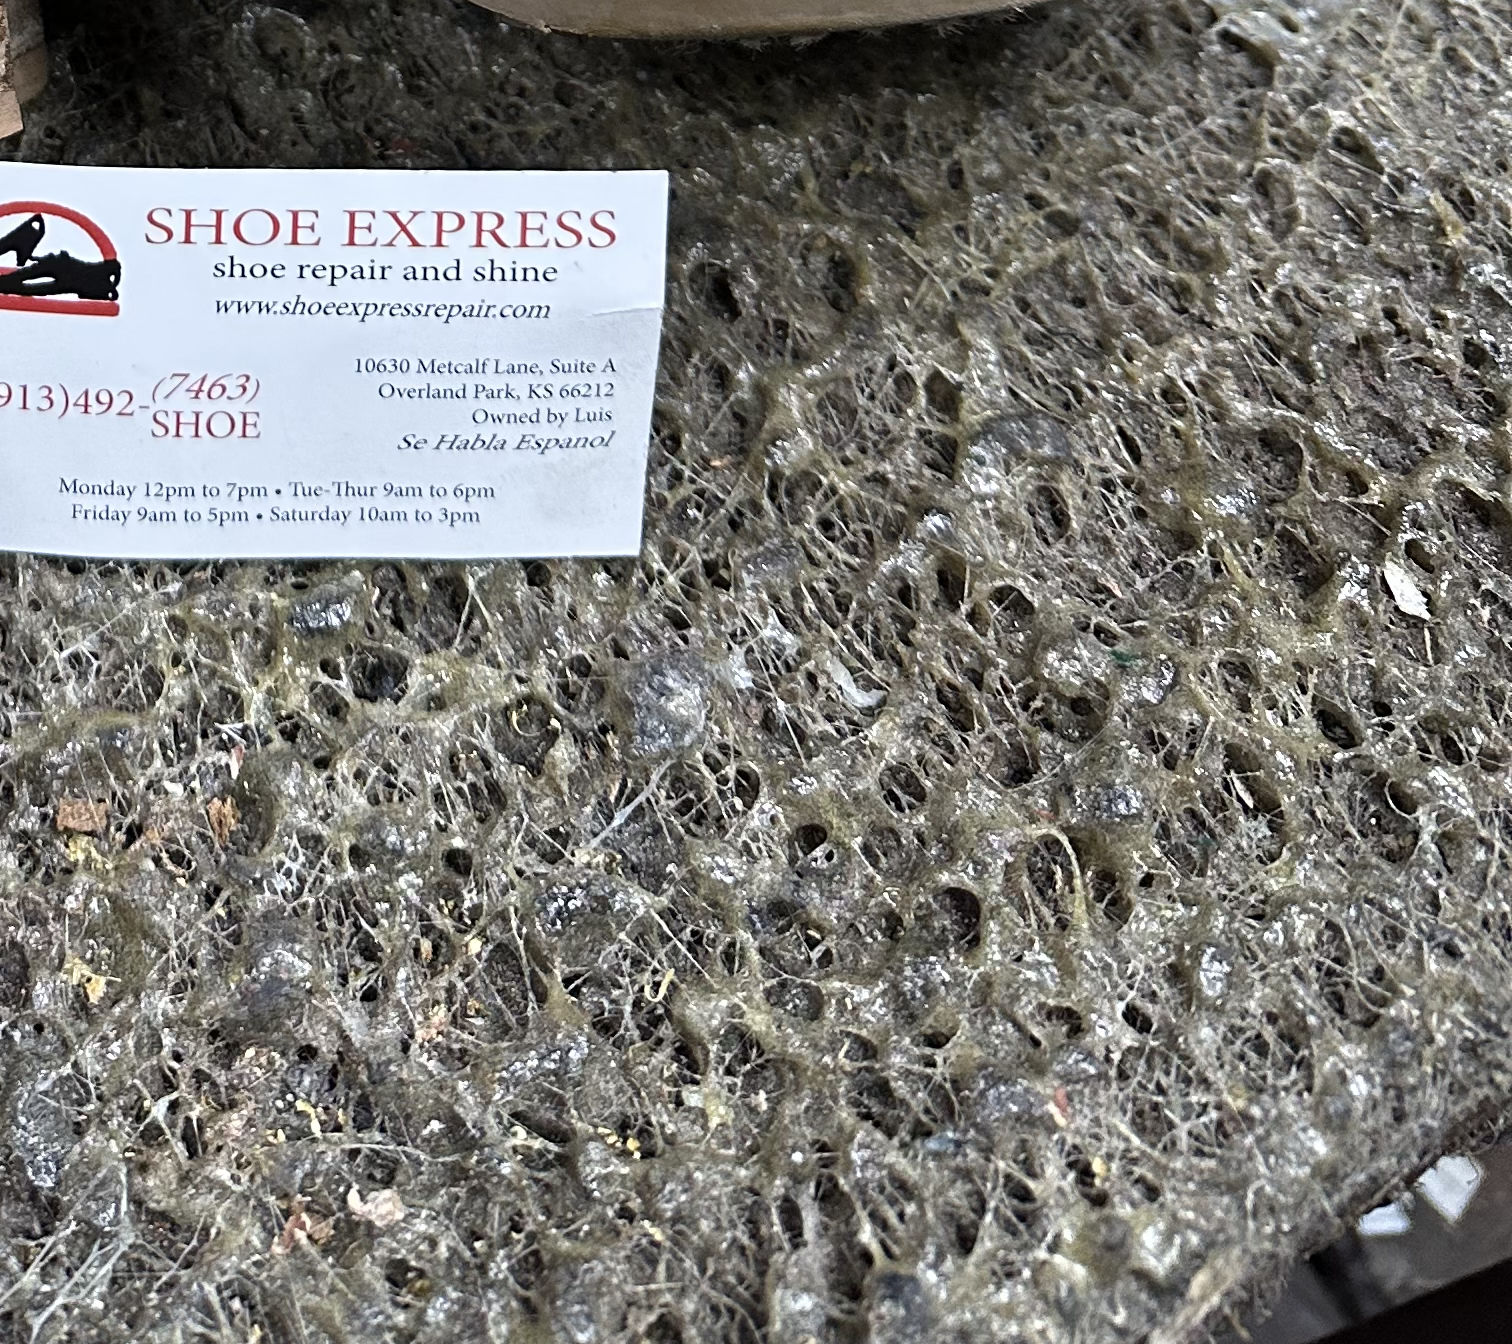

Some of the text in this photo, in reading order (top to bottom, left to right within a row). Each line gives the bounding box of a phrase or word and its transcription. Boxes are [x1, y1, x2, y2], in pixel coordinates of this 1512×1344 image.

[144, 207, 617, 249] SHOE EXPRESS
[212, 254, 558, 287] shoe repair and shine
[215, 294, 551, 324] www.shoeexpressrepair.com
[355, 357, 617, 377] 10630 Metcalf Lane, Suite A
[151, 372, 261, 405] (7463)
[378, 382, 615, 401] Overland Park, KS 66212
[150, 409, 261, 439] SHOE
[471, 406, 613, 429] Owned by Luis
[396, 429, 617, 456] Se Habla Espanol
[58, 477, 496, 504] Monday 12pm to 7pm Tue-Thur 9am to 6pm
[71, 503, 481, 529] Friday 9am to 5pm Saturday 10am to 3pm
